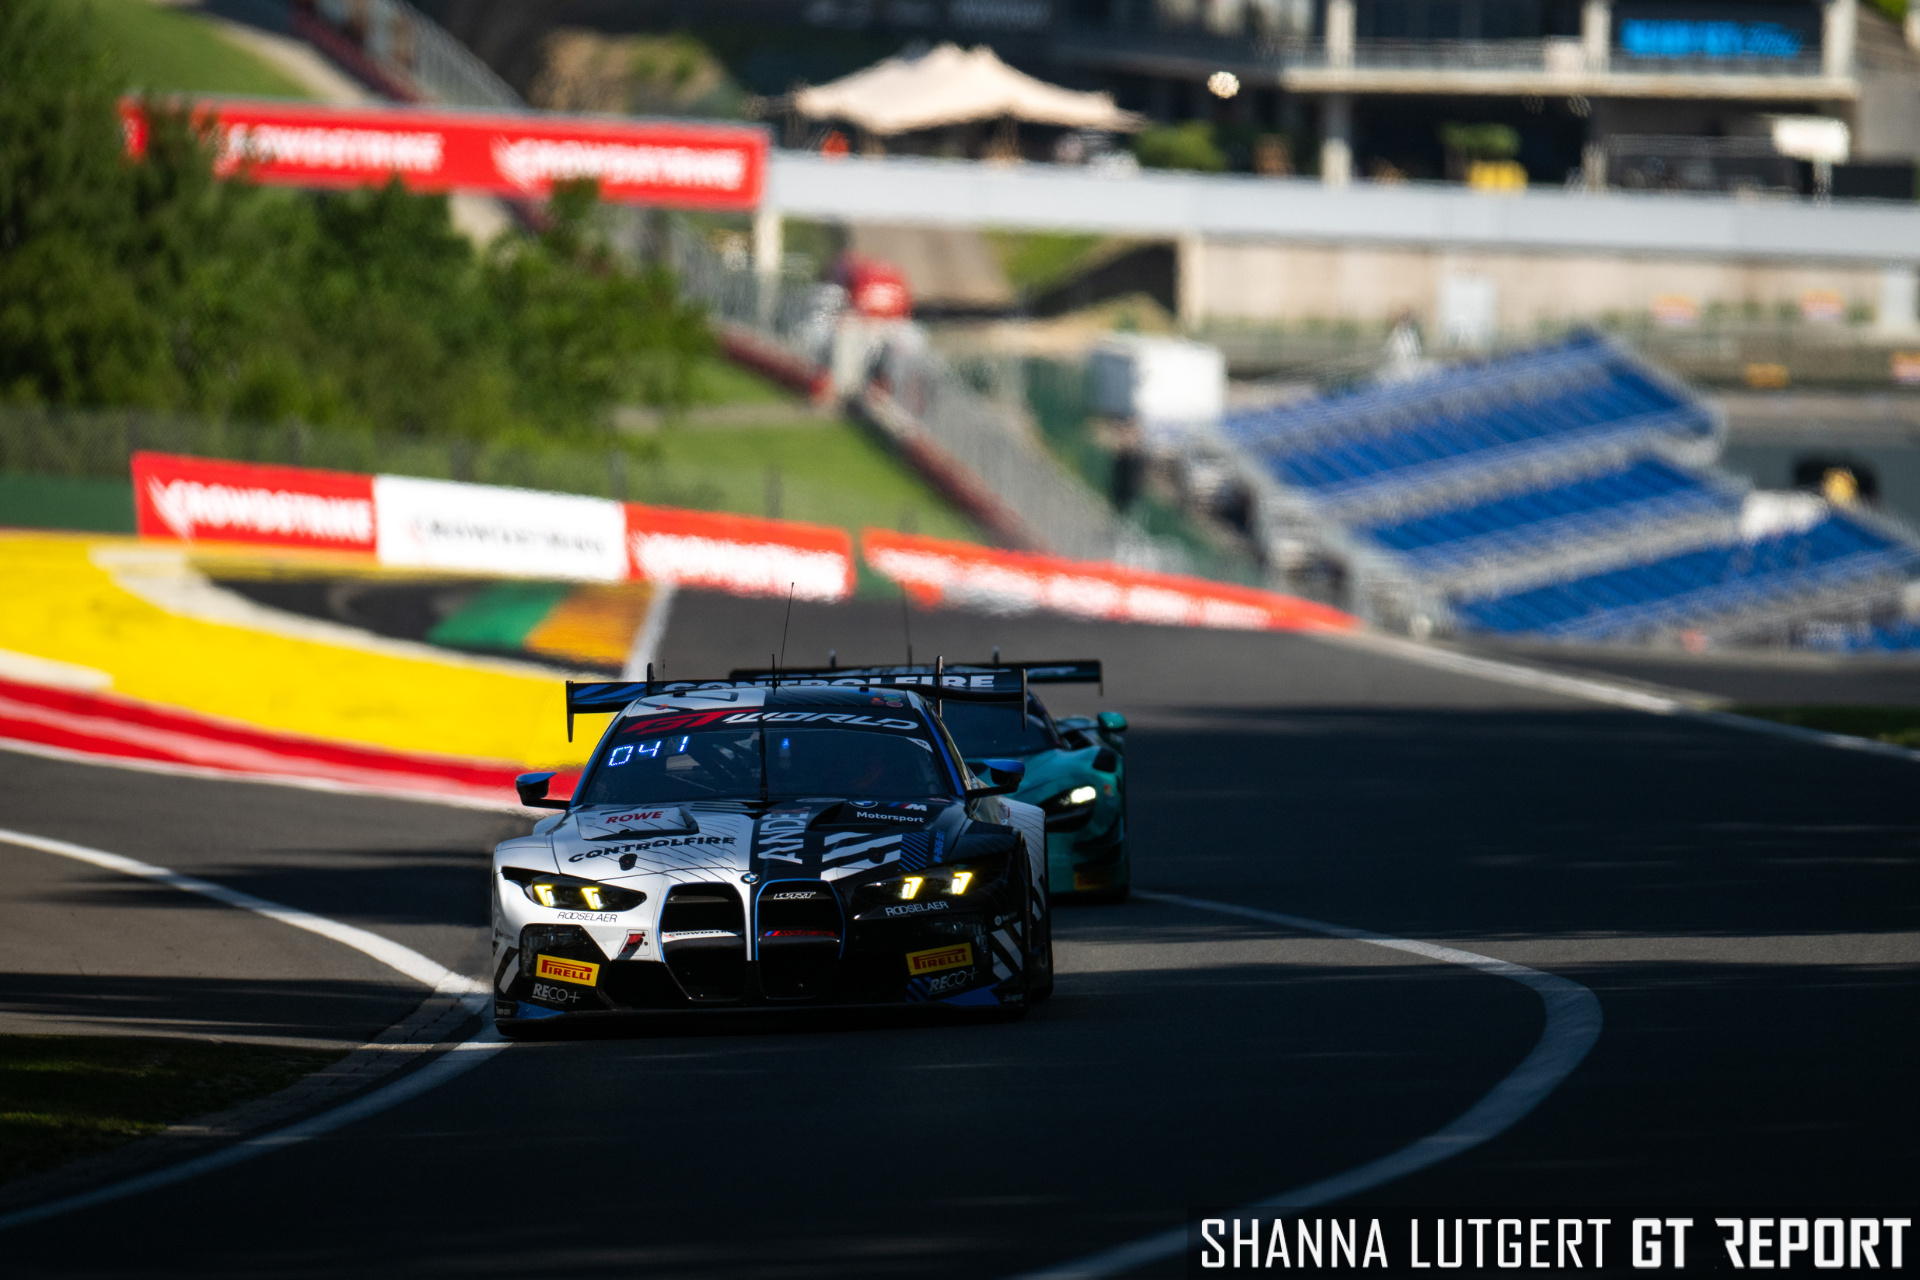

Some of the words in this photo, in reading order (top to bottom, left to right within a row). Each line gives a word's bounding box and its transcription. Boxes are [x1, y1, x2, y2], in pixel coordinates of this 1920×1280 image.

[622, 708, 760, 735] GT
[721, 711, 920, 731] WORLD
[608, 735, 689, 767] 041
[605, 811, 664, 824] ROWE
[856, 811, 925, 824] Motorsport
[568, 836, 737, 863] CONTROLFIRE
[668, 928, 743, 938] CROWDSTR
[912, 947, 967, 970] PIRELLI
[541, 959, 593, 981] PIRELLI
